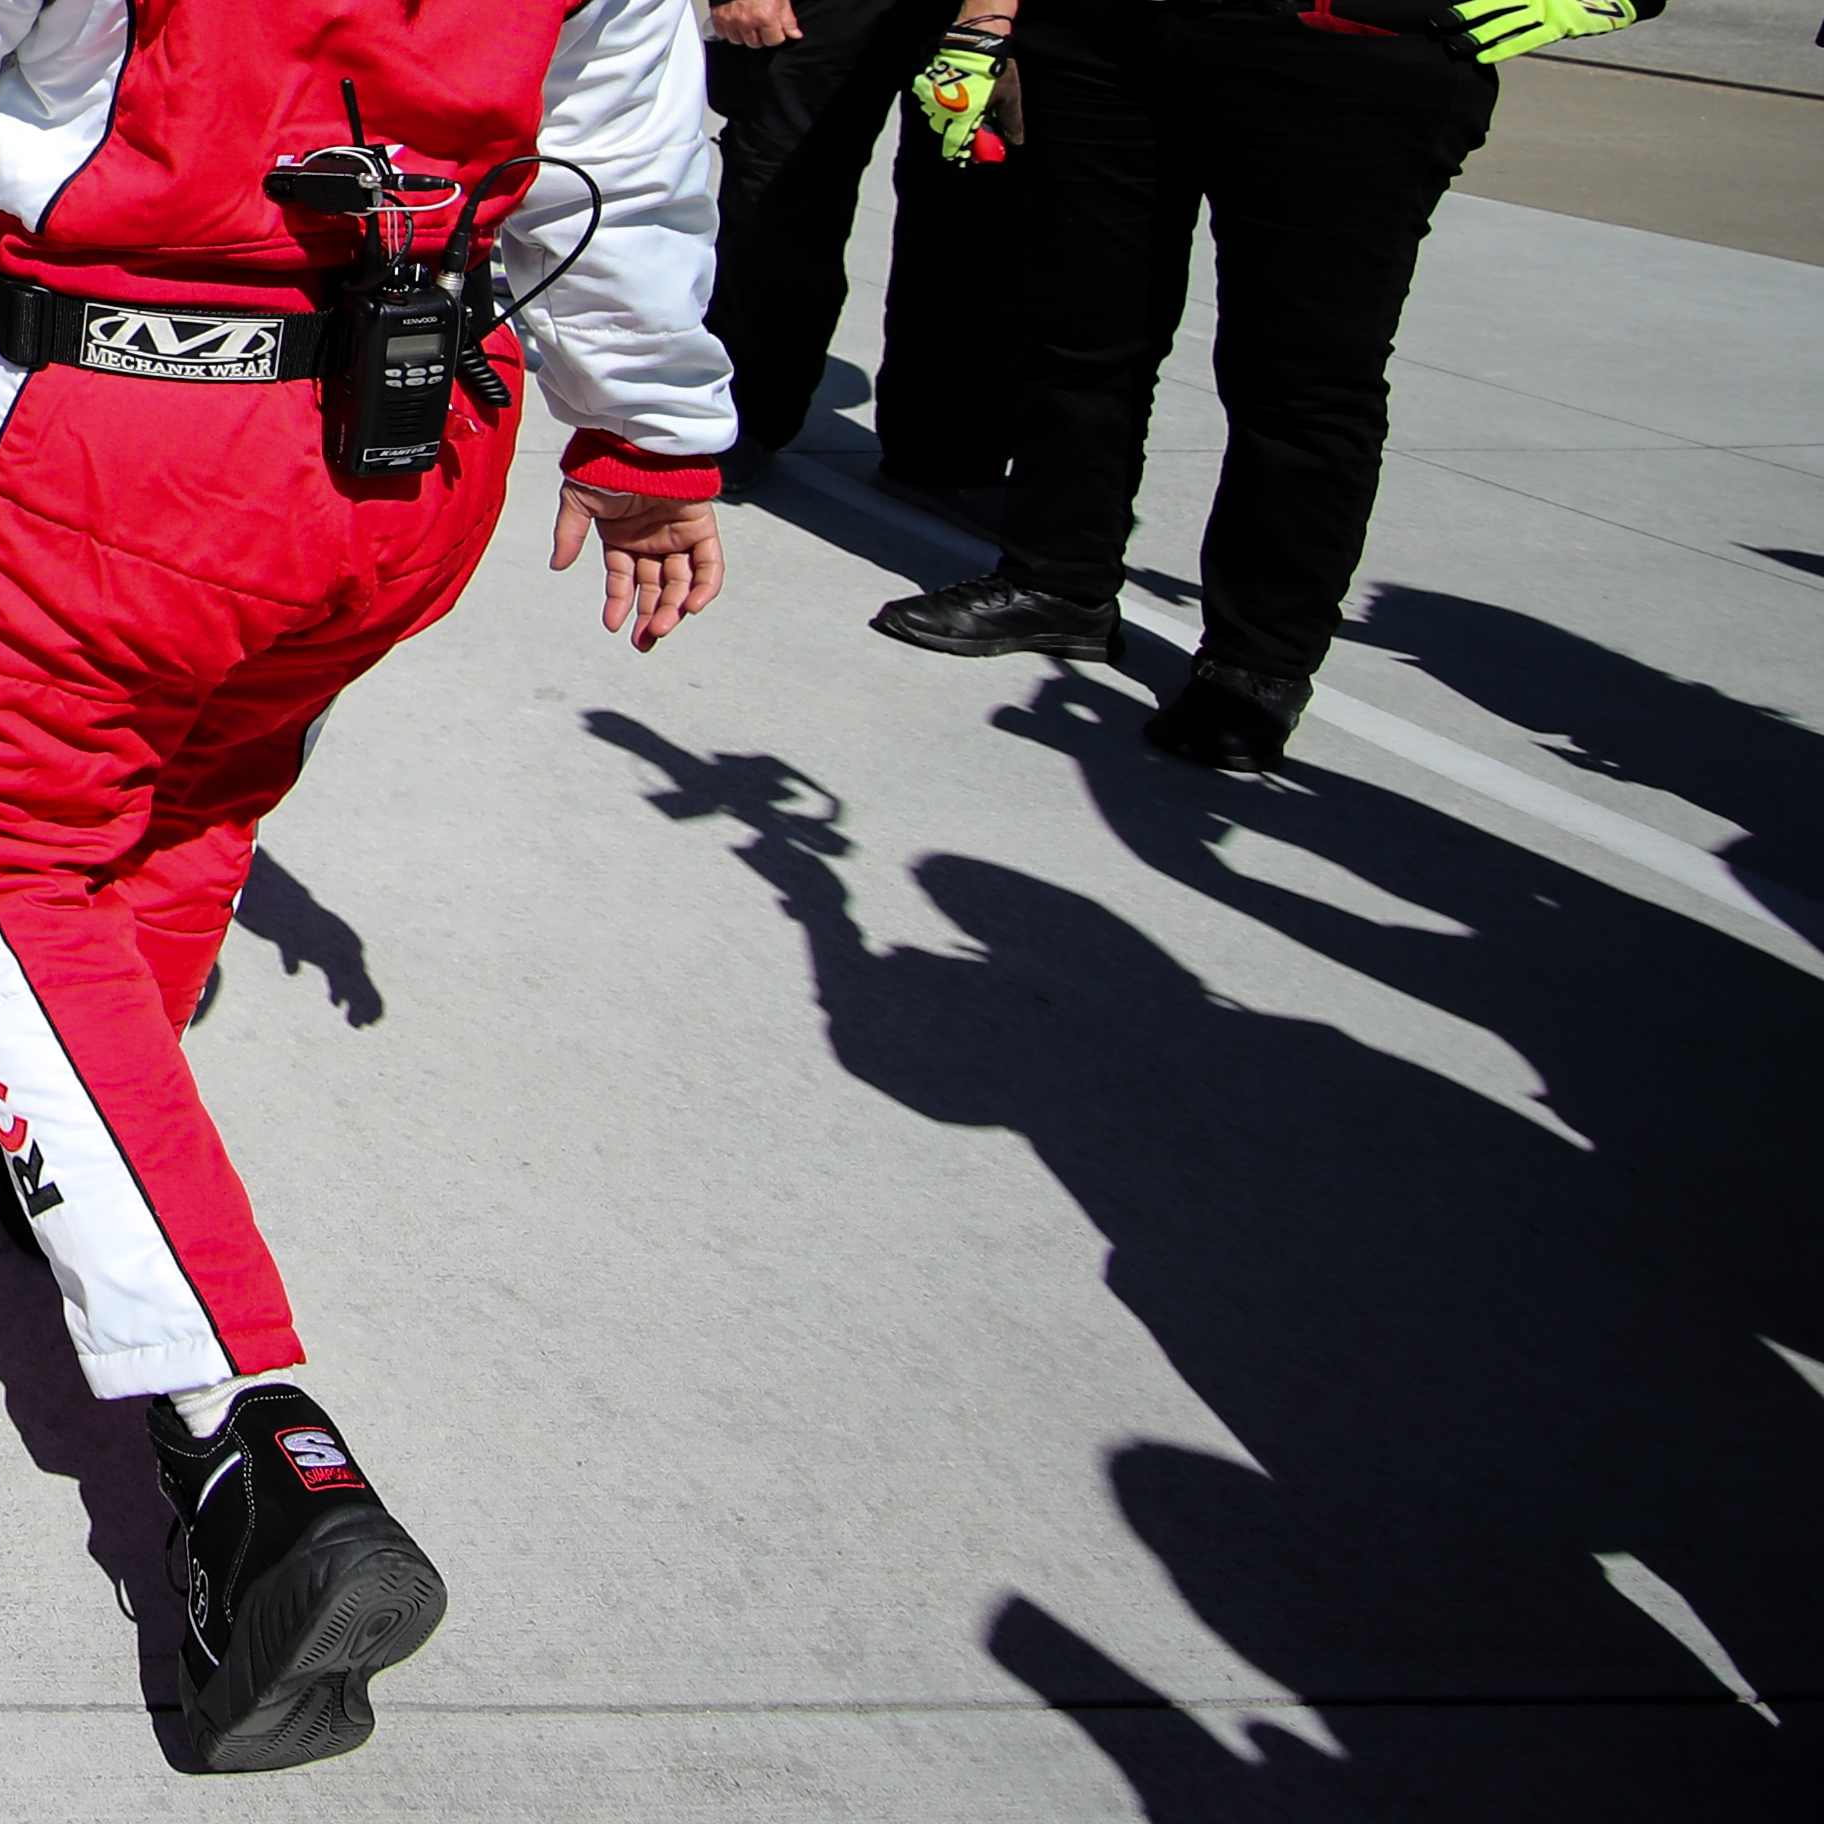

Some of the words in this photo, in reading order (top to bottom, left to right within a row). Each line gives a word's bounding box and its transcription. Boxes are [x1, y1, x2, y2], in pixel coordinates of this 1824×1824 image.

[925, 61, 972, 87] 27
[402, 316, 438, 326] KENWOOD
[86, 342, 206, 377] MECHANIX
[206, 357, 273, 378] WEAR
[283, 1430, 347, 1467] S
[305, 1467, 359, 1485] SIMPSON
